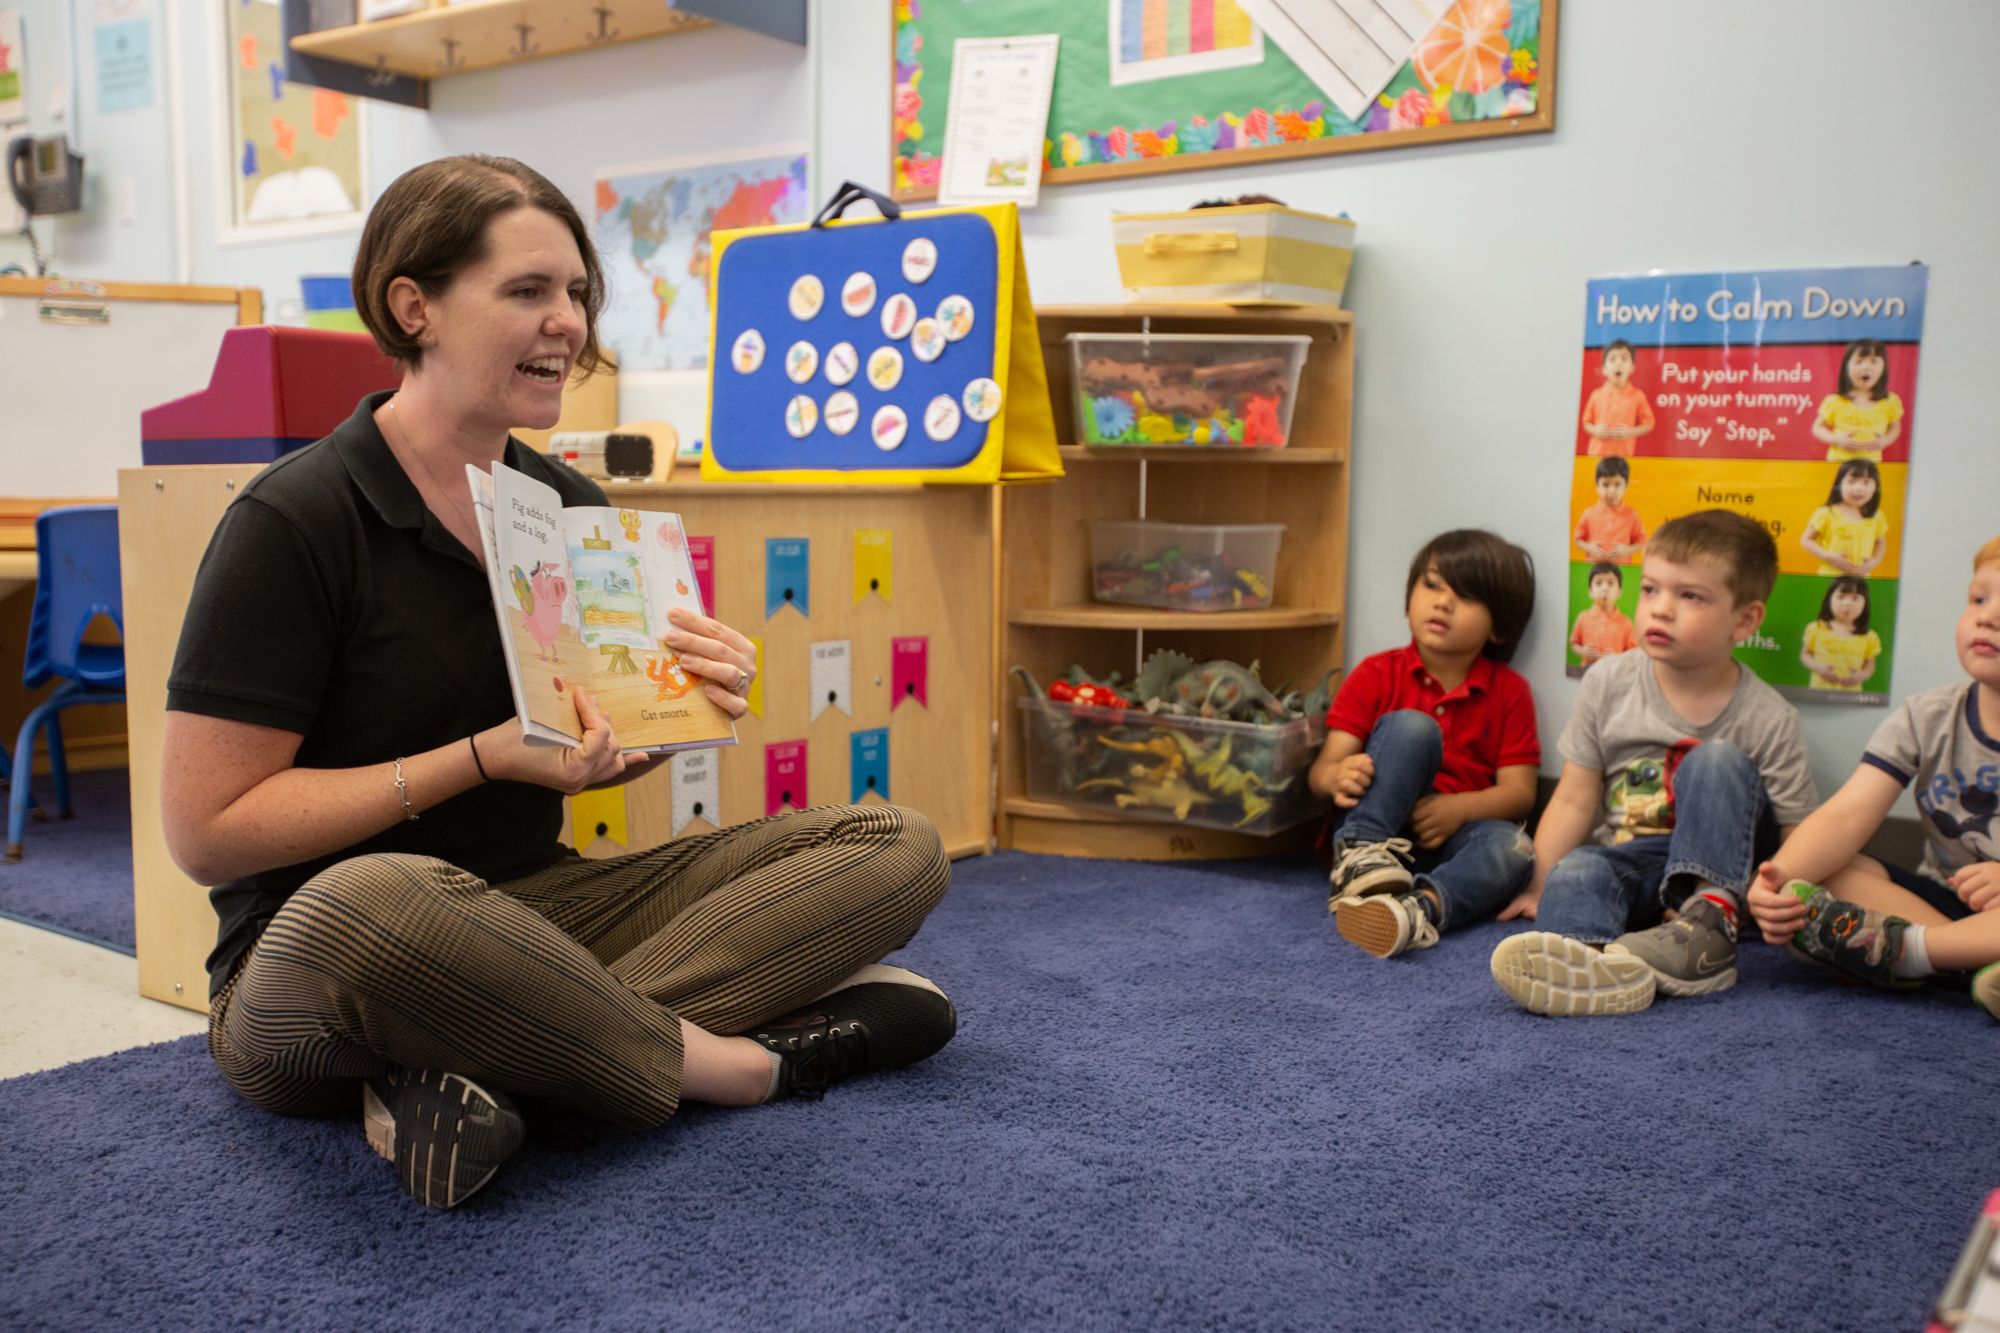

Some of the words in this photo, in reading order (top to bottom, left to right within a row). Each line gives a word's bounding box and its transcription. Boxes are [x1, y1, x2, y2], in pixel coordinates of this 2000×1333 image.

[1597, 293, 1662, 325] How
[1668, 298, 1699, 323] to
[1706, 288, 1794, 321] Calm
[1803, 286, 1906, 319] Down
[1661, 362, 1698, 383] Put
[1702, 369, 1749, 391] your
[1753, 361, 1812, 383] hands
[1656, 393, 1681, 407] on
[1685, 393, 1732, 415] your
[1735, 390, 1814, 415] tummy.
[1675, 418, 1712, 448] Say
[1716, 416, 1788, 448] "Stop."
[1697, 485, 1755, 504] Name
[512, 498, 525, 517] Pig
[526, 506, 544, 521] adds
[513, 520, 527, 533] and
[528, 527, 534, 536] a
[641, 709, 658, 721] Cat
[659, 709, 692, 720] snorts.
